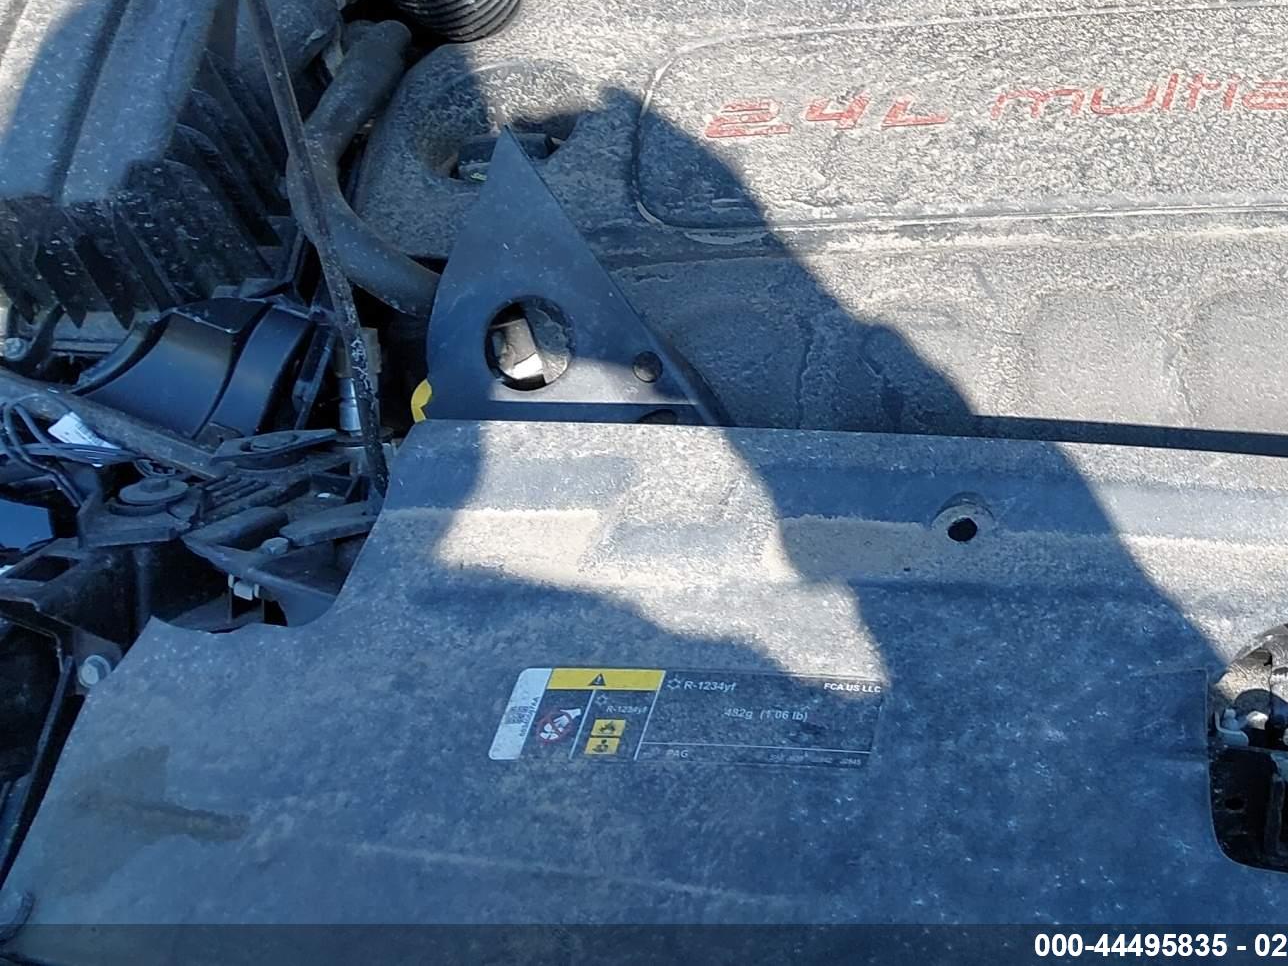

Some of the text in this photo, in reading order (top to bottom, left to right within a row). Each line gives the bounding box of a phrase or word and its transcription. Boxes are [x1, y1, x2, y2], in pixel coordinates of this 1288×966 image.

[683, 680, 737, 693] R-1234yf
[823, 682, 882, 694] FCA US LLC
